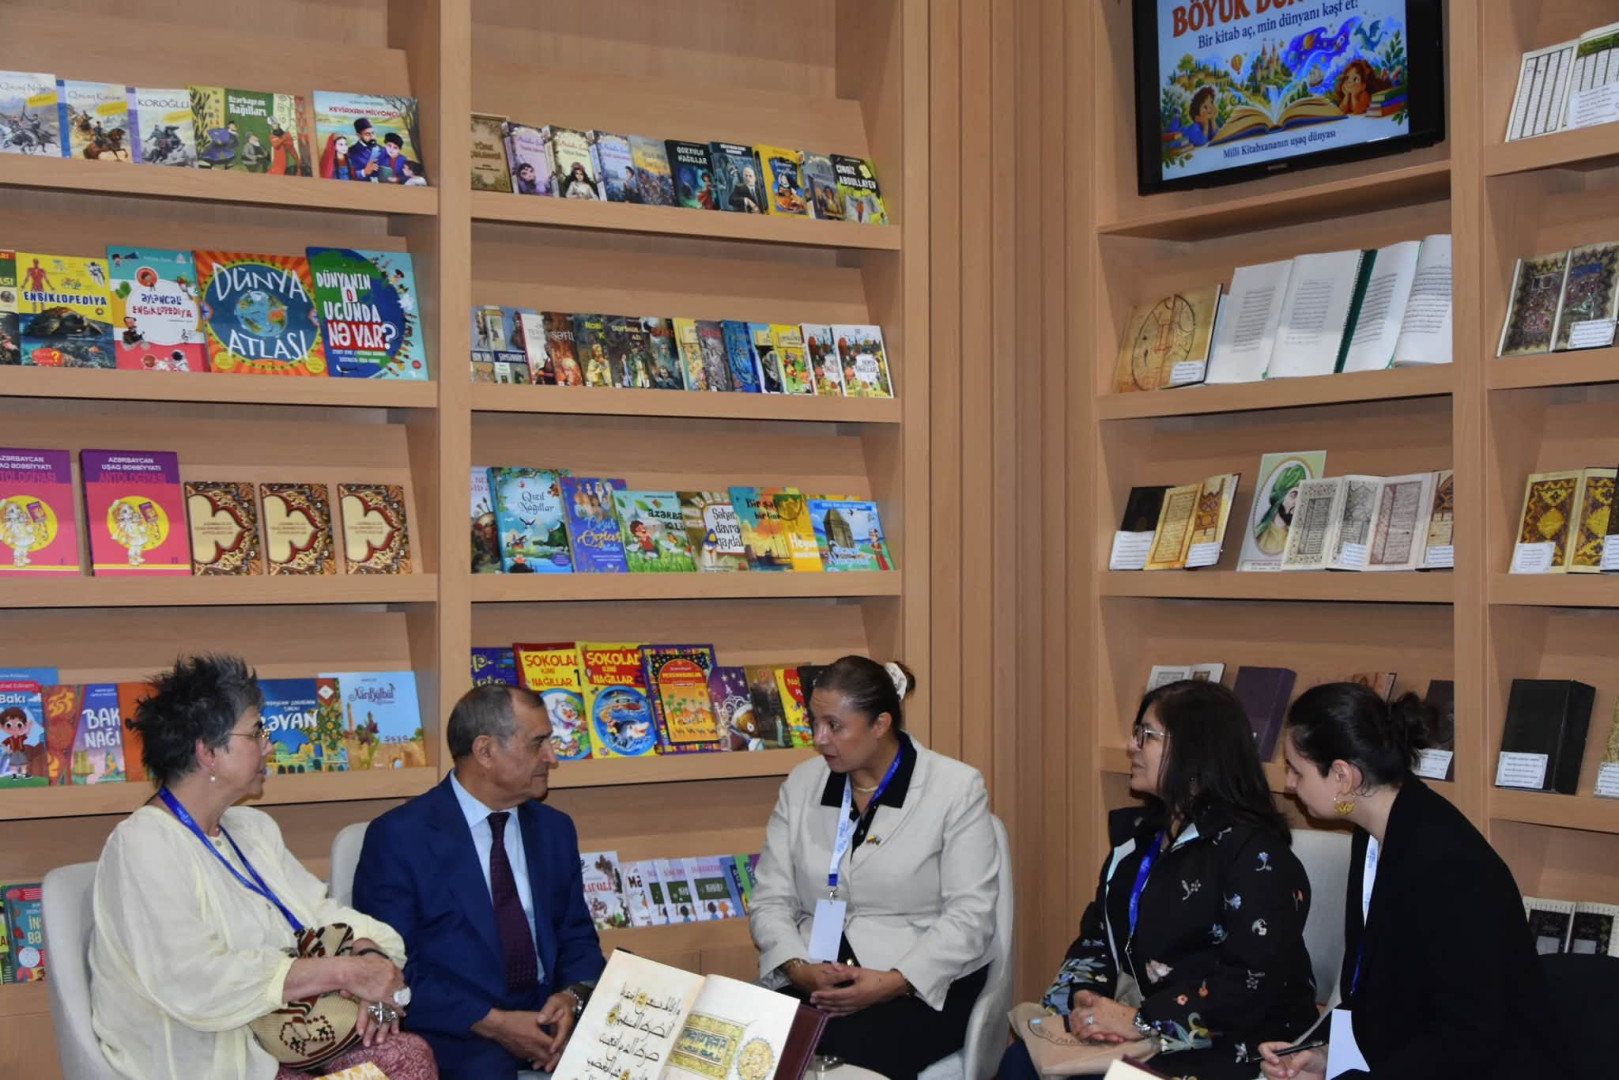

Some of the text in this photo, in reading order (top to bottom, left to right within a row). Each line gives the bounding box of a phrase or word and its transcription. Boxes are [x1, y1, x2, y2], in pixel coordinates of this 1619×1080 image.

[1198, 35, 1213, 49] Bir
[1215, 27, 1240, 45] kitab
[1241, 24, 1256, 40] aç,
[1258, 19, 1277, 34] min
[1279, 11, 1320, 30] dünyanı
[212, 261, 308, 303] DÜNYA
[316, 269, 372, 290] DÜNYANIN
[323, 301, 382, 323] UCUNDA
[228, 329, 309, 361] ATLASI
[327, 322, 396, 350] NƏ VAR?
[108, 456, 154, 464] AZƏRBAYCAN
[262, 709, 318, 731] ƏVAN
